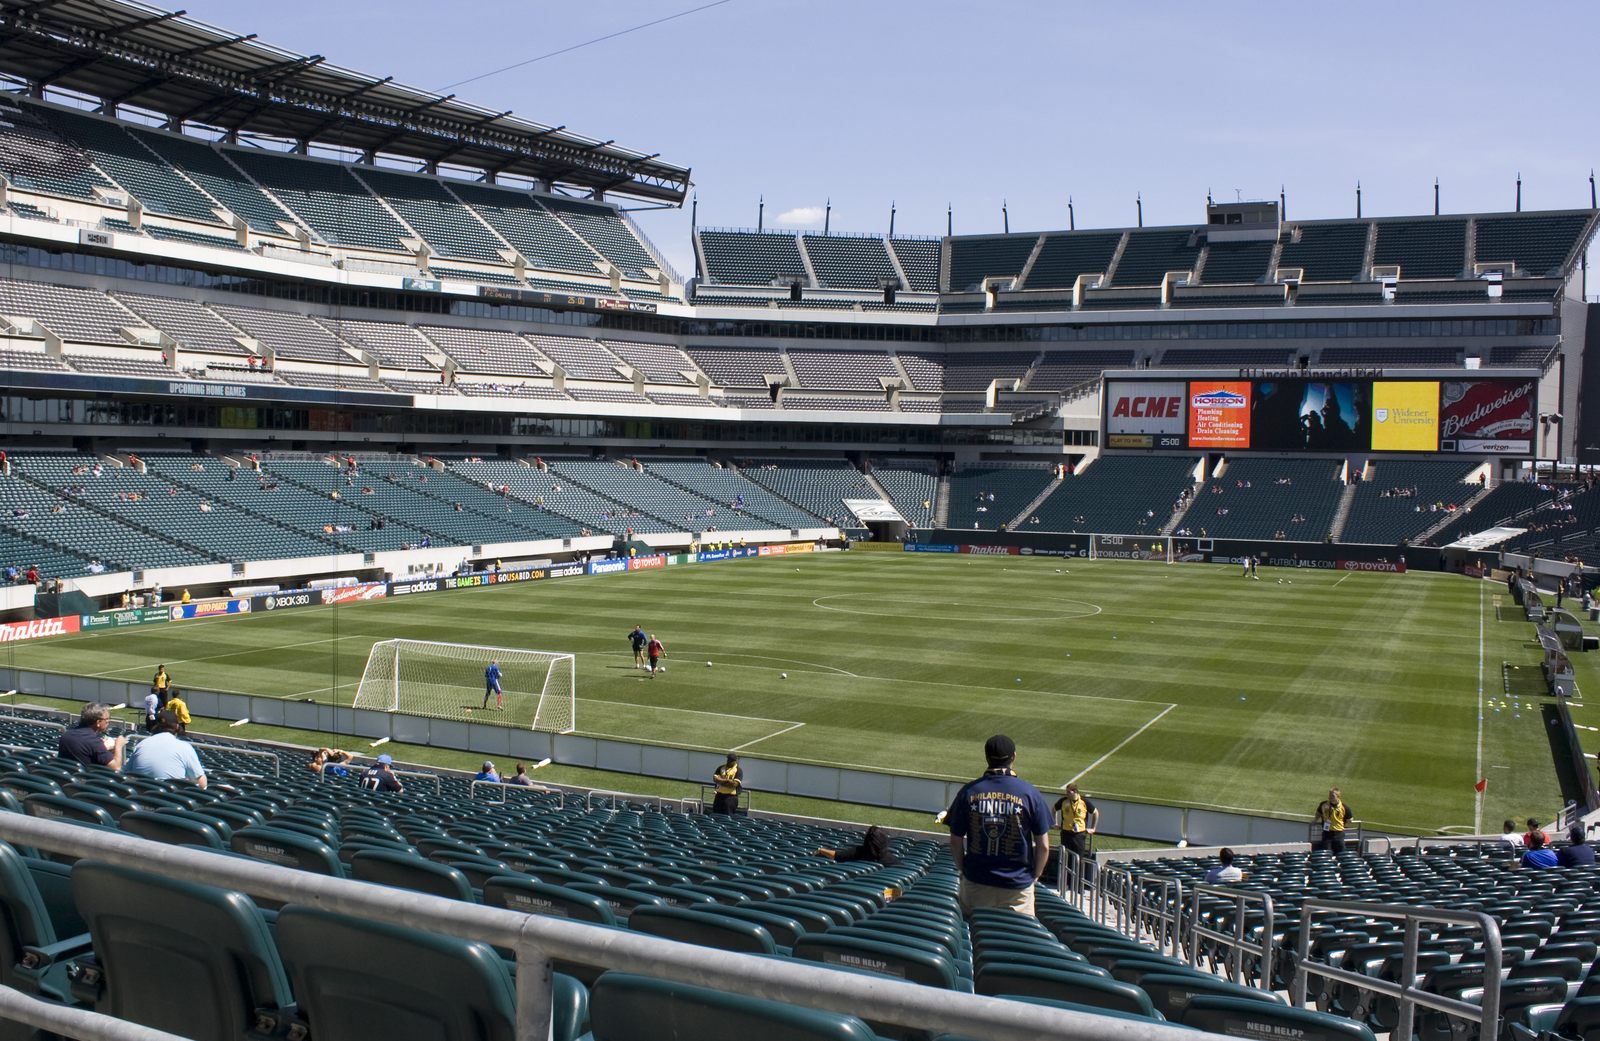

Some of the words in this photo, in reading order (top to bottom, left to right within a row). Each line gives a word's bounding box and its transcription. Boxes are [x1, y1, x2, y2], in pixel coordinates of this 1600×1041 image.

[169, 382, 205, 395] UPCOMING
[206, 384, 224, 396] HOME
[224, 386, 246, 397] GAMES
[1112, 396, 1182, 418] ACME
[1197, 408, 1223, 416] Plumbing
[1392, 407, 1429, 417] Widener
[1442, 381, 1534, 438] Budweiser
[1208, 421, 1244, 429] Conditioning
[1393, 415, 1436, 427] University
[1482, 443, 1510, 451] verizon
[591, 562, 626, 574] Panasonic
[641, 557, 662, 567] TOYOTA
[1359, 562, 1398, 571] TOYOTA
[563, 566, 583, 576] adidas
[445, 579, 457, 588] THE
[457, 577, 472, 587] GAME
[472, 576, 481, 586] IS
[481, 575, 489, 585] IN
[489, 574, 496, 584] US
[498, 571, 545, 583] GOUSABID.COM
[411, 581, 438, 593] adidas
[275, 596, 295, 607] XBOX
[295, 594, 310, 605] 360
[325, 585, 367, 605] Budweiser
[196, 603, 211, 612] AUTO
[211, 601, 229, 611] PARTS
[970, 791, 1024, 806] PHILADELPHIA
[979, 800, 1014, 816] UNION
[840, 954, 860, 964] NEED
[862, 958, 887, 969] HELP?
[1246, 1021, 1271, 1033] NEED
[1274, 1026, 1304, 1037] HELP?
